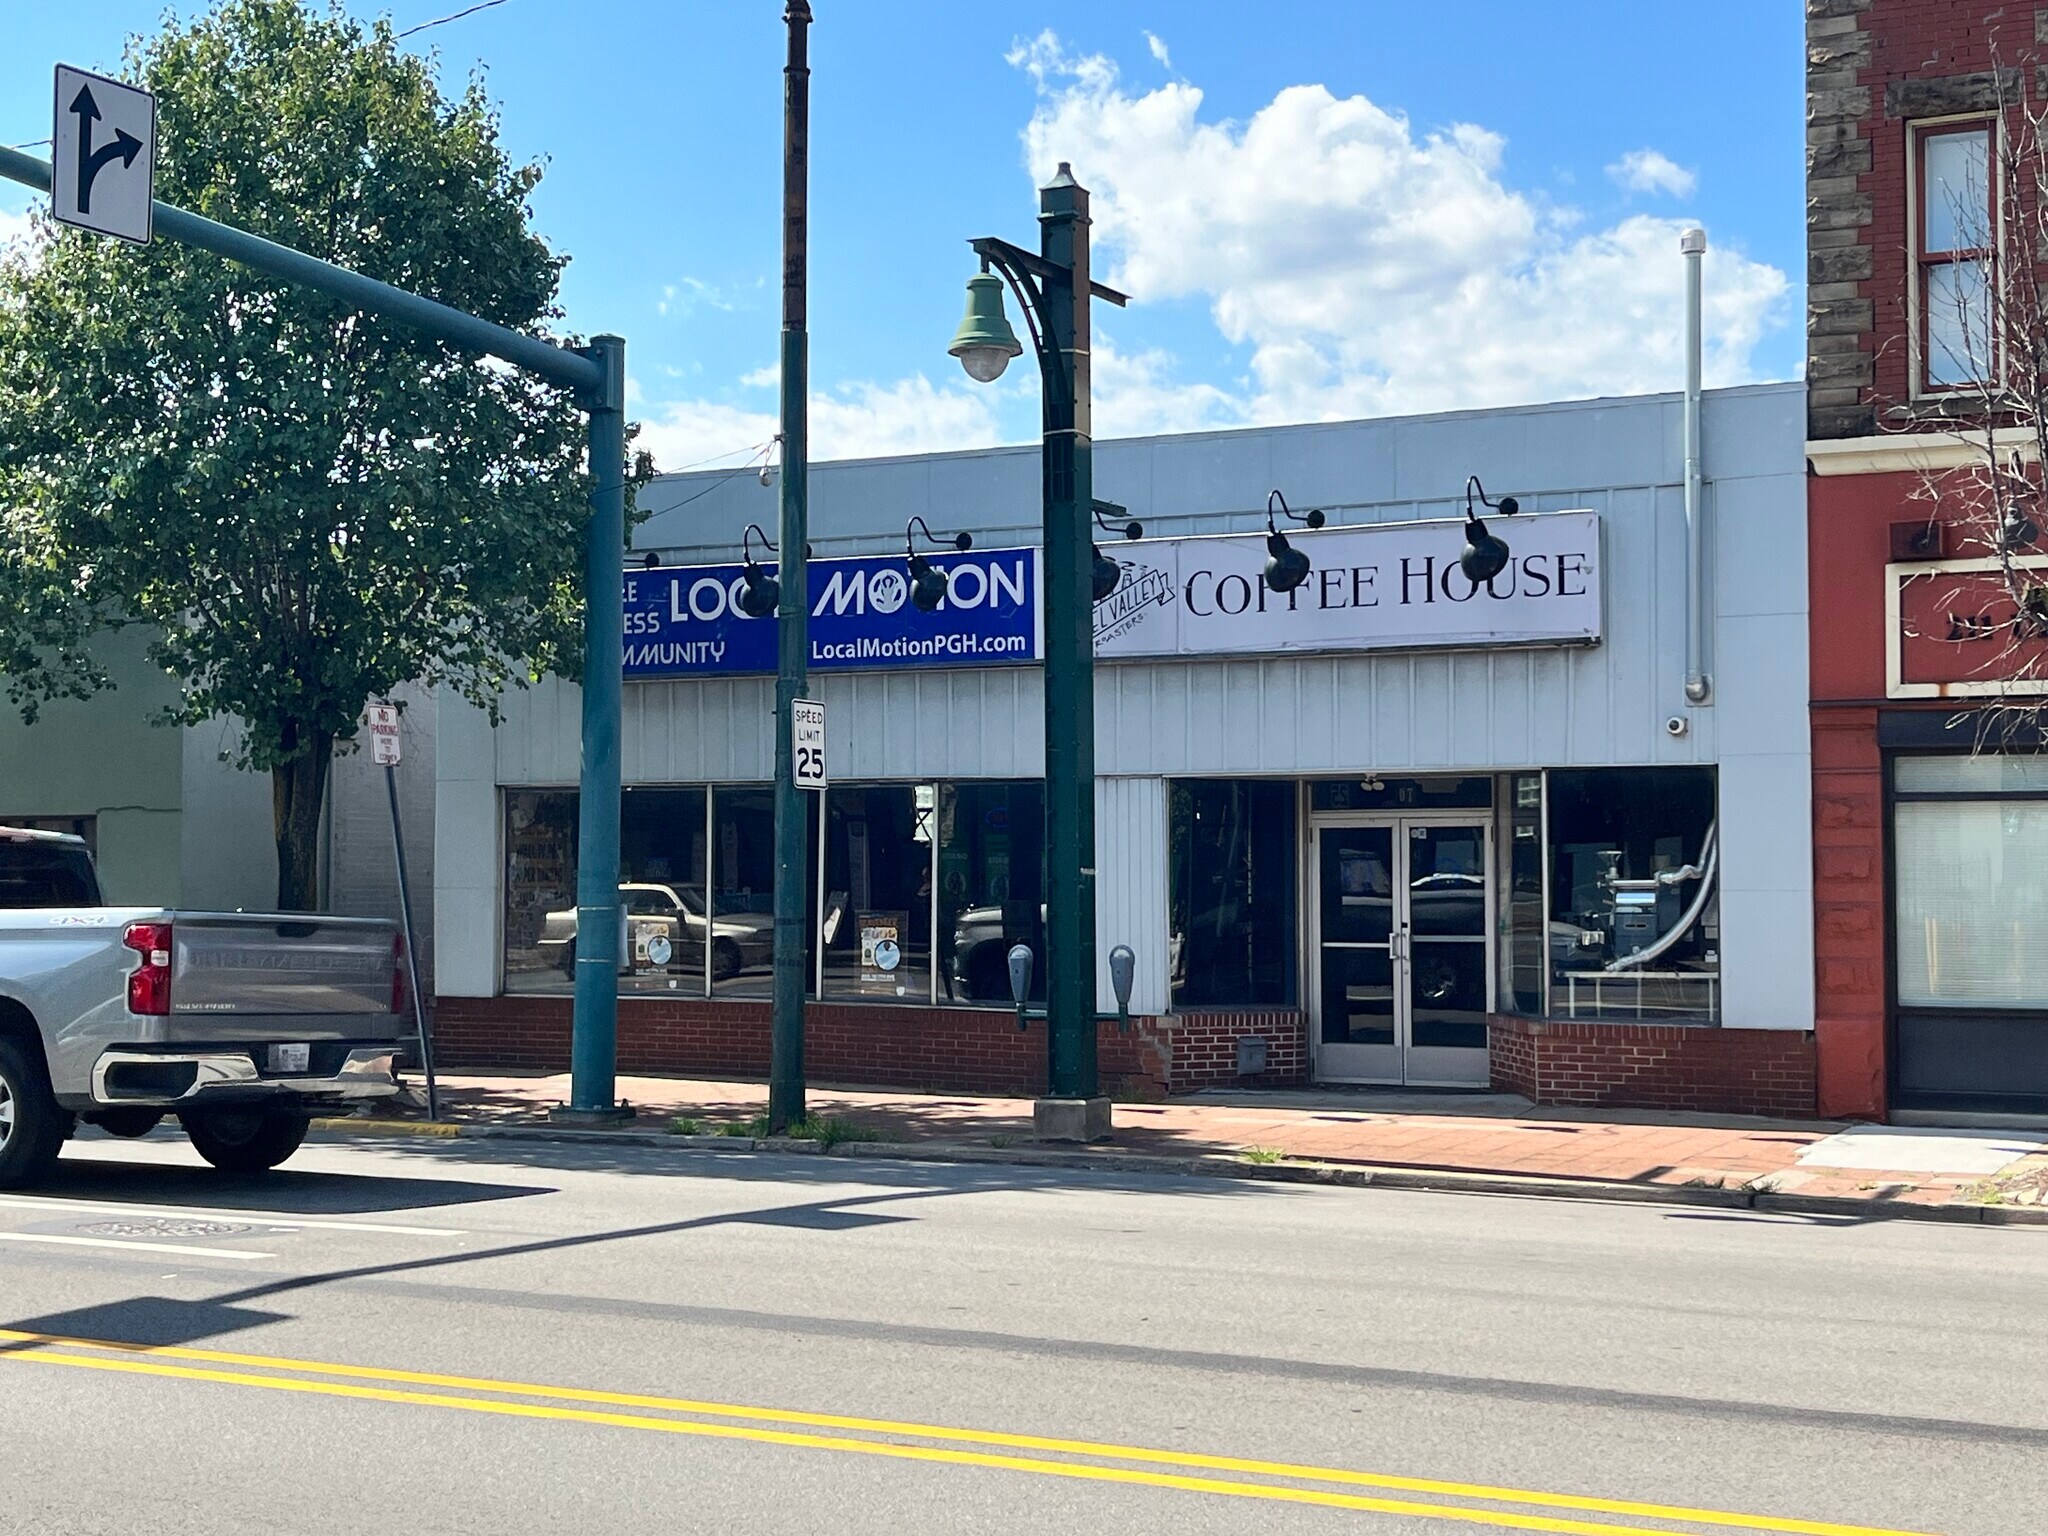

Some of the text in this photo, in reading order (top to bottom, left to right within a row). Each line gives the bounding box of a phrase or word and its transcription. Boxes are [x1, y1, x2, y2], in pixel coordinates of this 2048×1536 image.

[1400, 553, 1586, 605] HOUSE
[1108, 574, 1156, 621] VALLEY
[812, 633, 1026, 660] LocalMotionPGH.com
[378, 711, 389, 723] NO
[795, 709, 823, 725] SPEED
[798, 729, 821, 742] LIMIT
[797, 747, 824, 780] 25
